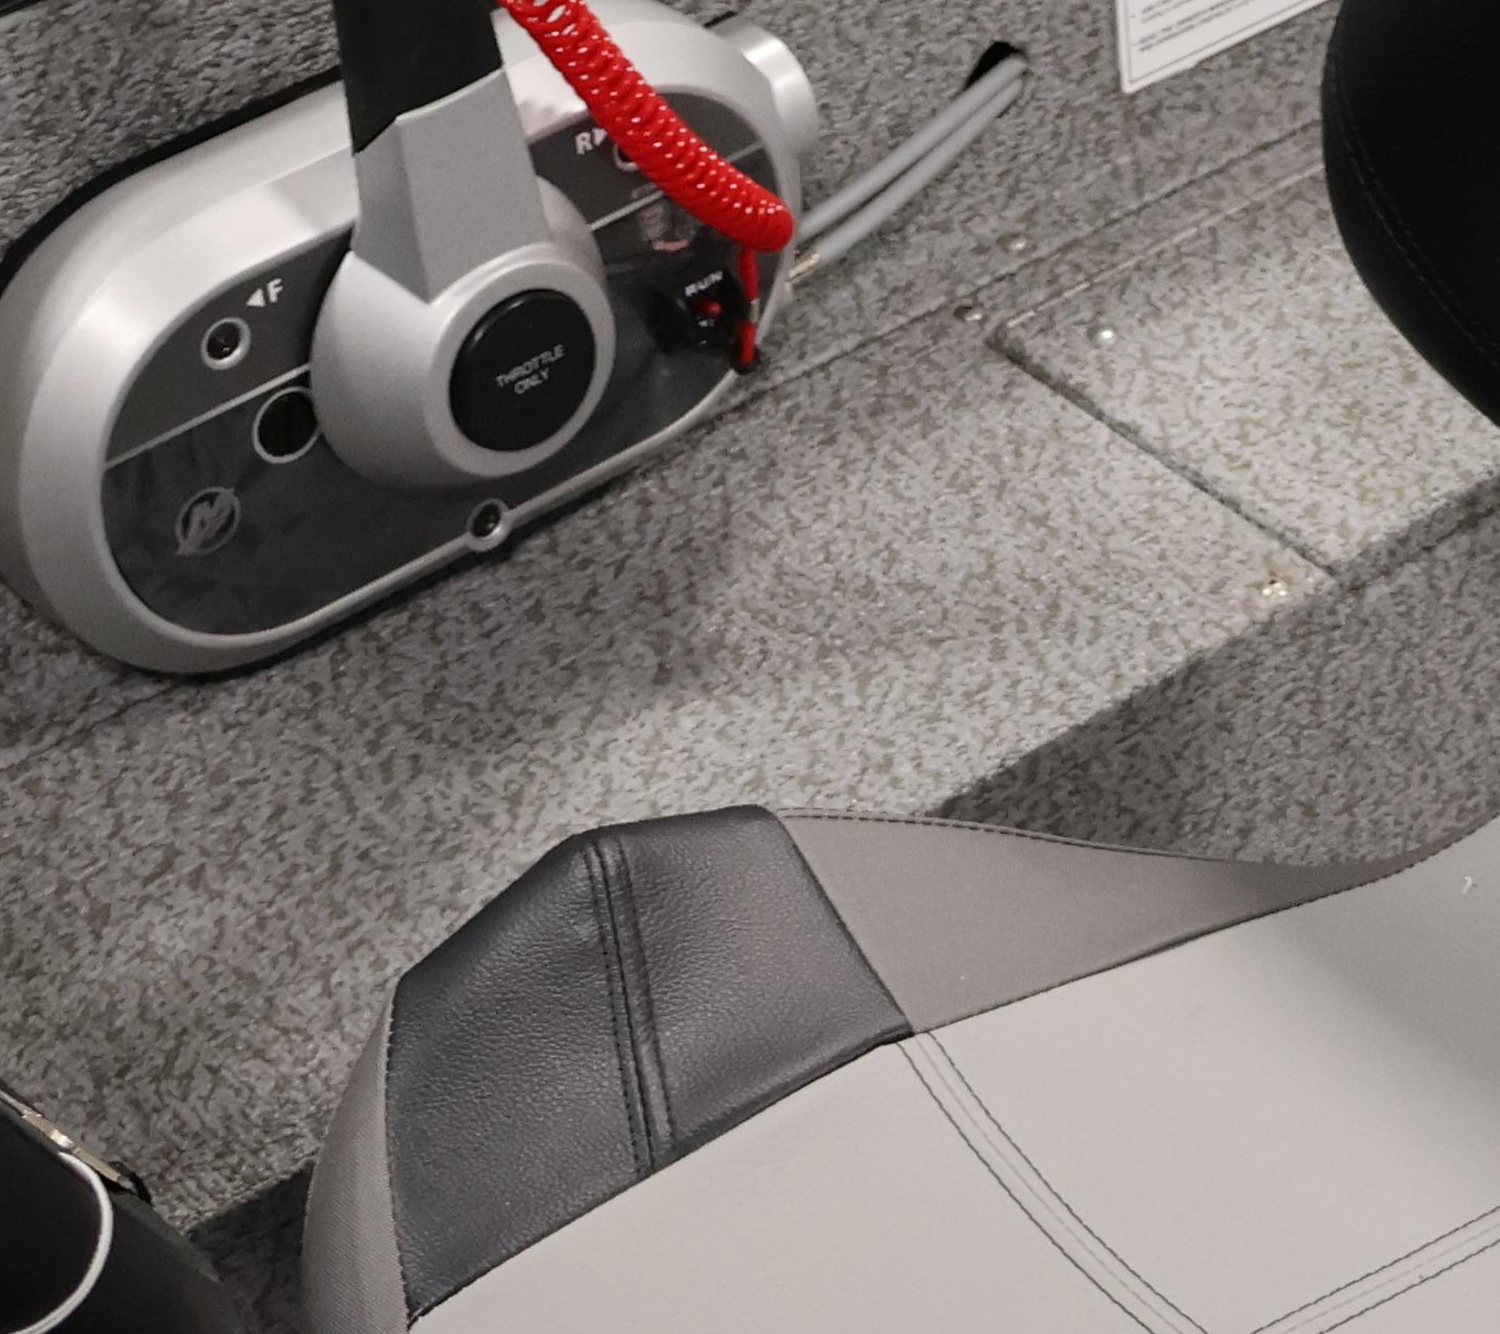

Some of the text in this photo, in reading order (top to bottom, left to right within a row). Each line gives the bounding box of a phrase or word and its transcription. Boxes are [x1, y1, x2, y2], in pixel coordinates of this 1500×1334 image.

[575, 131, 594, 154] R
[267, 277, 283, 303] F
[496, 344, 565, 387] THROTTLE
[514, 367, 549, 394] ONLY
